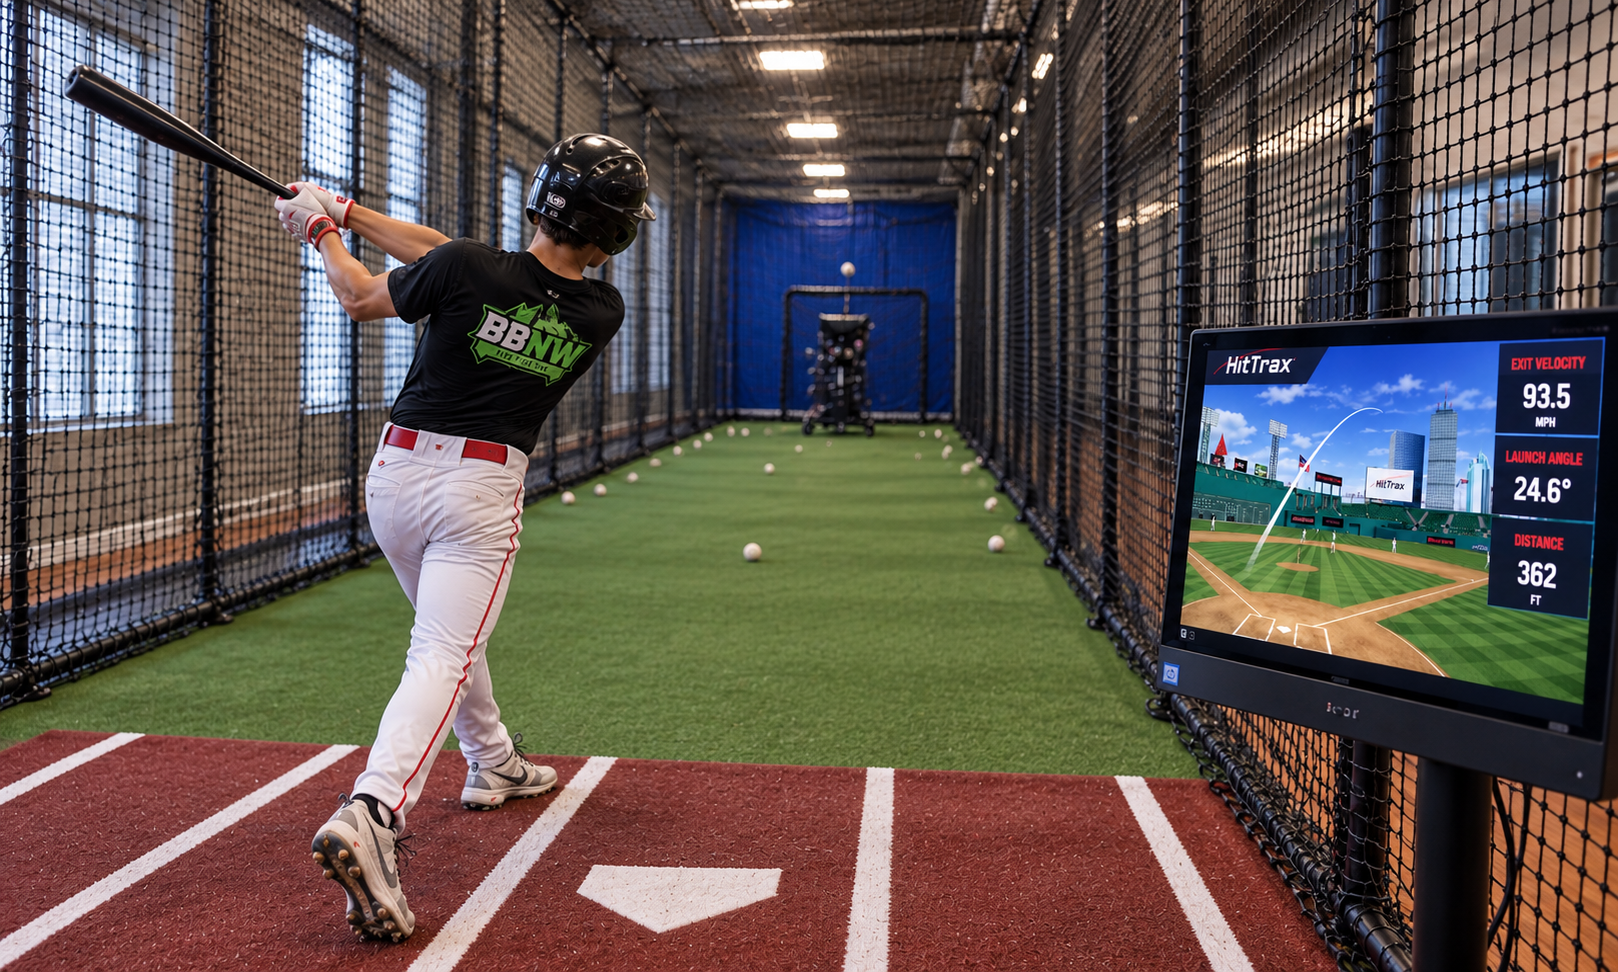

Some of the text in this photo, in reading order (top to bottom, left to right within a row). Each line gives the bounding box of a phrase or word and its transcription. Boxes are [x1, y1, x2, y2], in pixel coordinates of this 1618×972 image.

[475, 310, 587, 369] BBNW
[1225, 355, 1293, 374] HitTrax
[1511, 356, 1586, 371] EXIT VELOCITY
[1523, 383, 1571, 409] 93.5
[1535, 416, 1556, 428] MPH
[1505, 450, 1583, 466] LAUNCH ANGLE
[1375, 479, 1405, 491] HitTrax
[1513, 475, 1572, 504] 24.6°
[1514, 533, 1564, 551] DISTANCE
[1517, 560, 1557, 589] 362
[1530, 594, 1542, 606] FT
